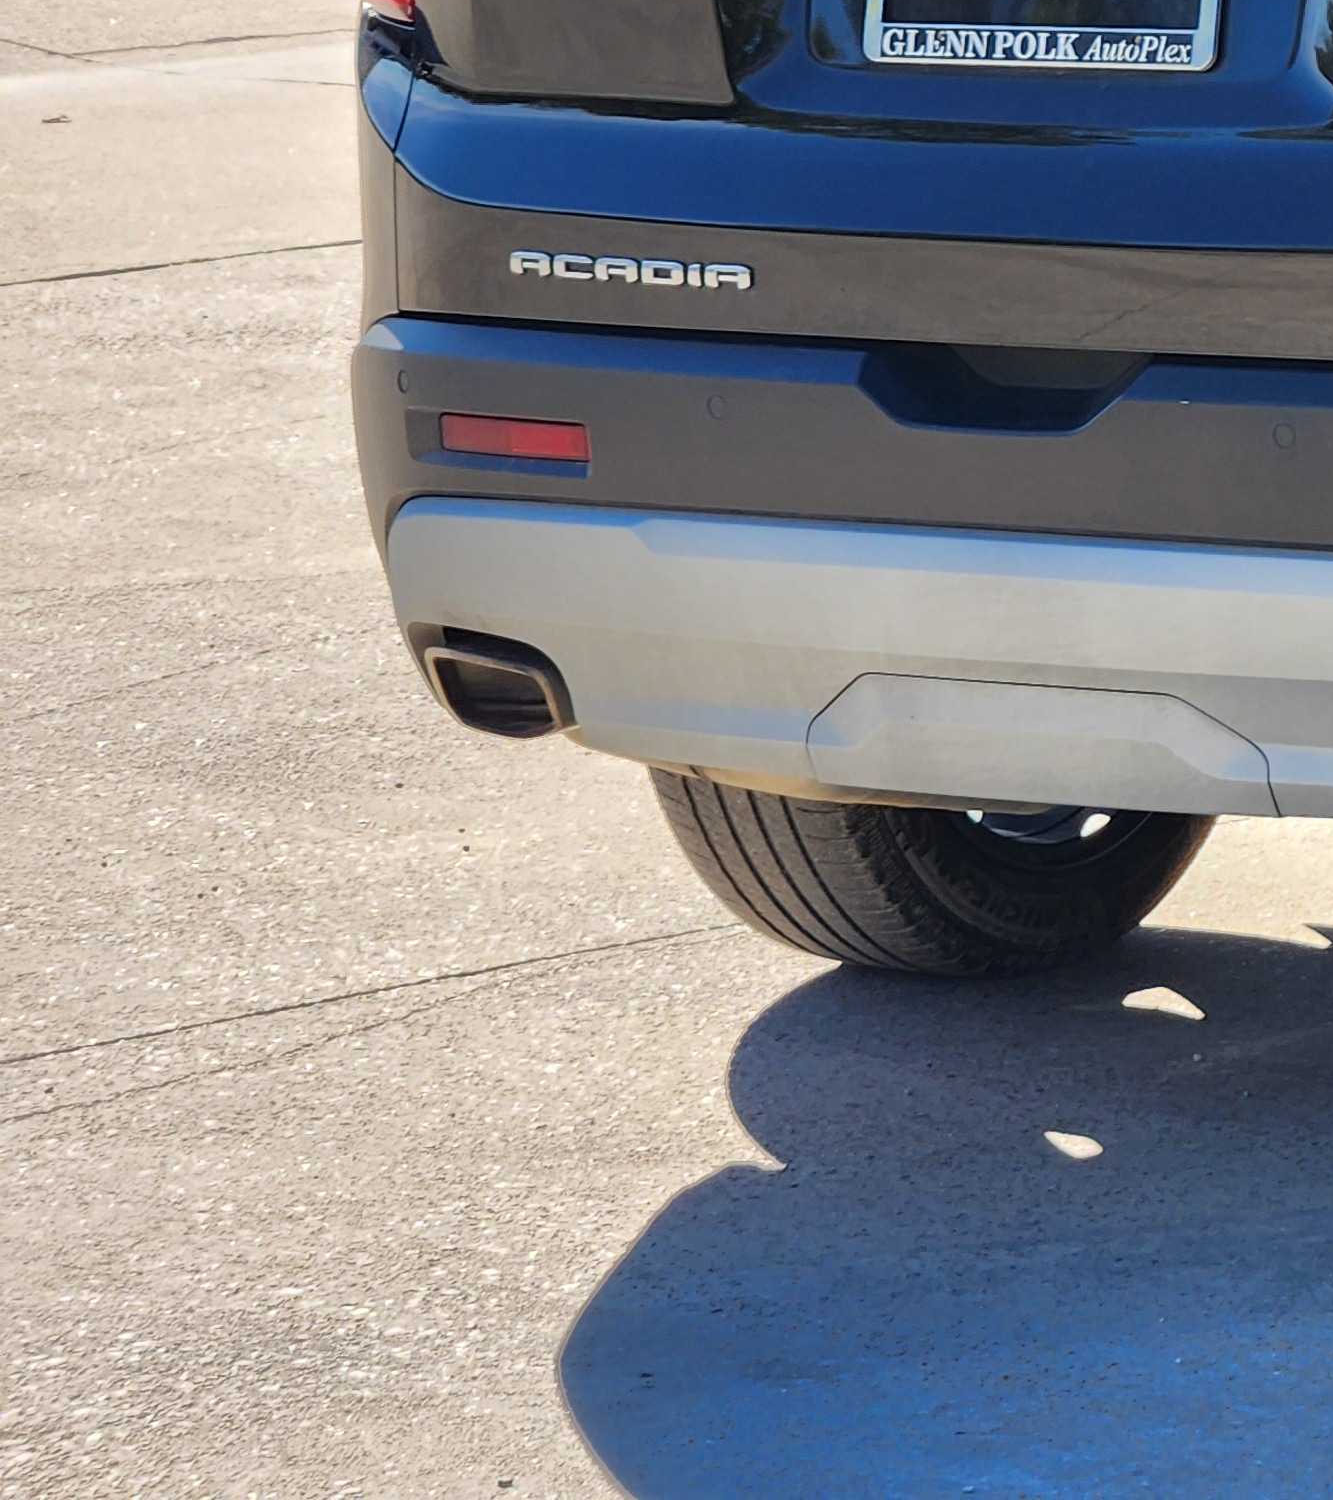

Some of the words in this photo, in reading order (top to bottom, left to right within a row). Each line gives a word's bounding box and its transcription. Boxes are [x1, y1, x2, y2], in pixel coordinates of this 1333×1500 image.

[881, 28, 991, 59] GLENN
[991, 31, 1079, 61] POLK
[1081, 34, 1192, 64] AutoPlex
[509, 250, 752, 290] ACADIA
